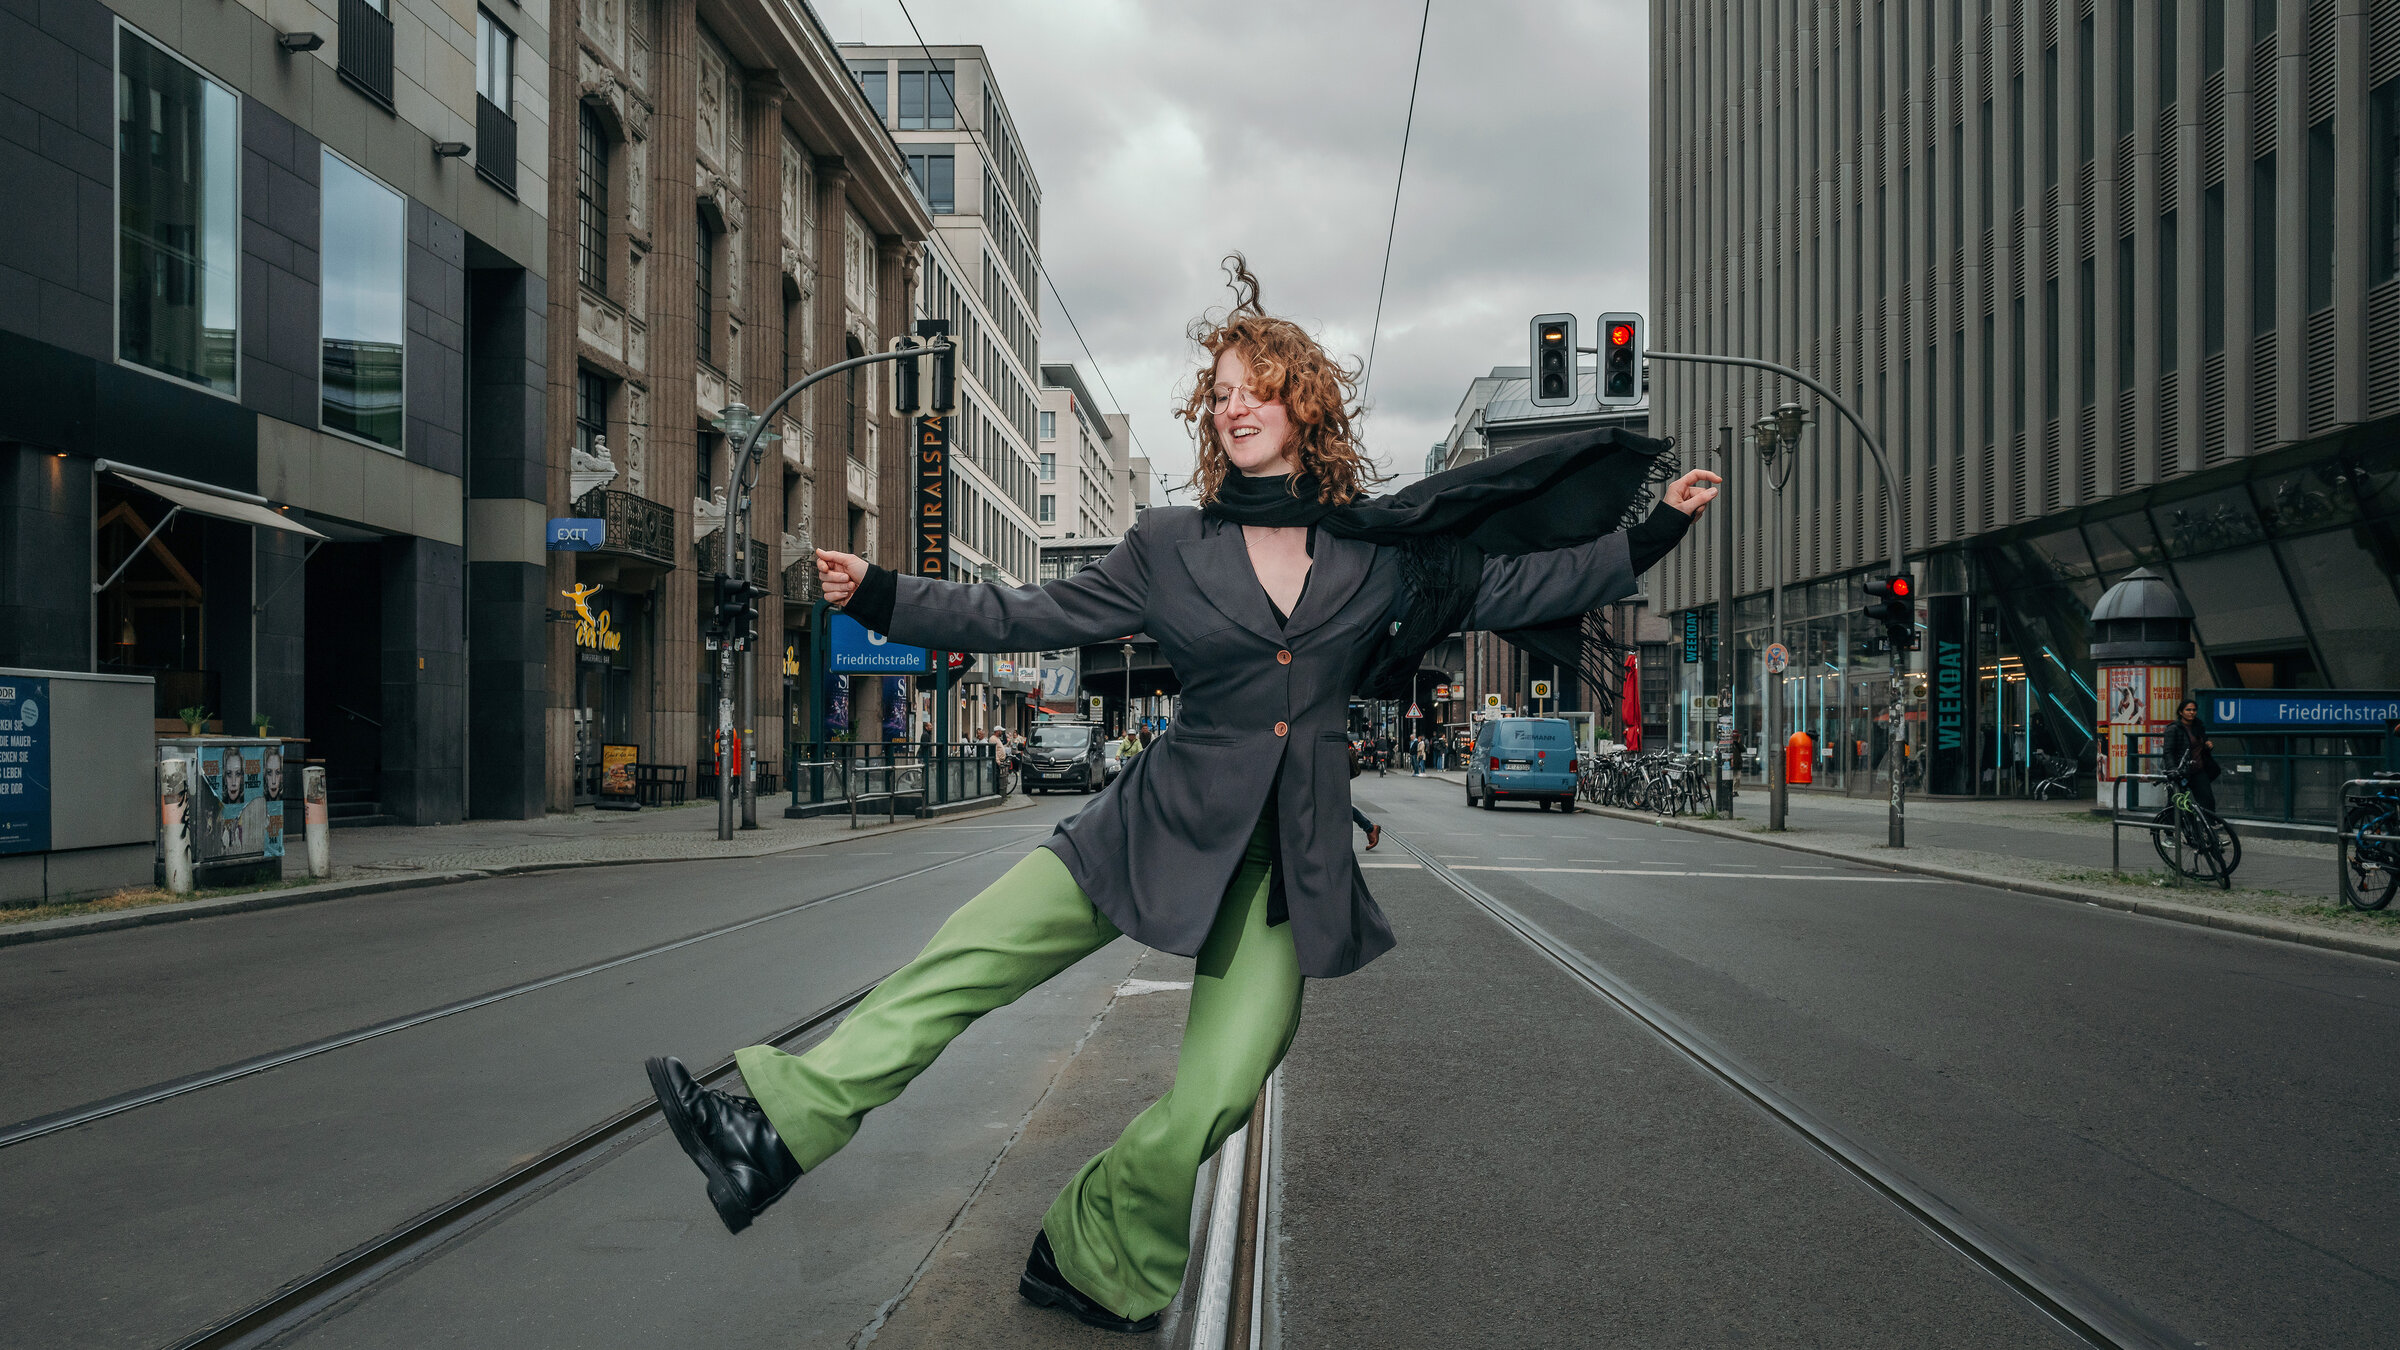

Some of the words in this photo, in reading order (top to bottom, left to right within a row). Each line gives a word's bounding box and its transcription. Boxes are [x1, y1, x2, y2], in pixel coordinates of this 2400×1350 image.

[923, 415, 942, 580] DMIRALSPA
[557, 528, 588, 541] EXIT
[1686, 611, 1697, 662] WEEKDAY
[836, 653, 920, 666] Friedrichstraße
[1938, 641, 1961, 750] WEEKDAY
[2219, 701, 2236, 721] U
[2279, 703, 2398, 720] Friedrichstraß
[10, 735, 31, 747] MAUER
[19, 751, 29, 763] SIE
[3, 767, 22, 779] LEBEN
